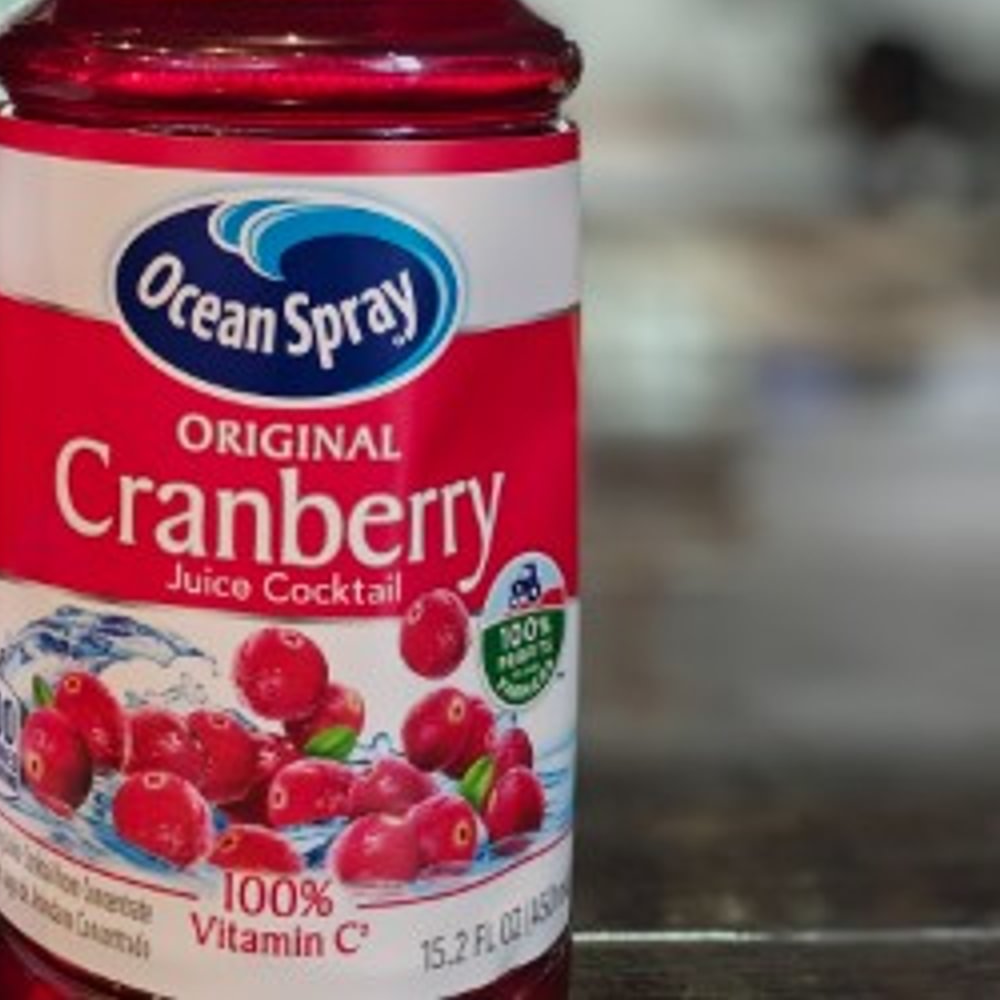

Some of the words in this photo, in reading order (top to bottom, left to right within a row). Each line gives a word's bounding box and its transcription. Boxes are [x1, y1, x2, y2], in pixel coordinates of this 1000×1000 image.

[137, 253, 276, 355] Ocean
[284, 268, 418, 370] Spray
[176, 413, 402, 462] ORIGINAL
[55, 437, 506, 594] Cranberry
[165, 562, 252, 601] Juice
[263, 569, 402, 606] Cocktail
[223, 871, 334, 918] 100%
[190, 911, 325, 957] Vitamin
[420, 928, 469, 973] 15.2
[474, 922, 496, 957] FL
